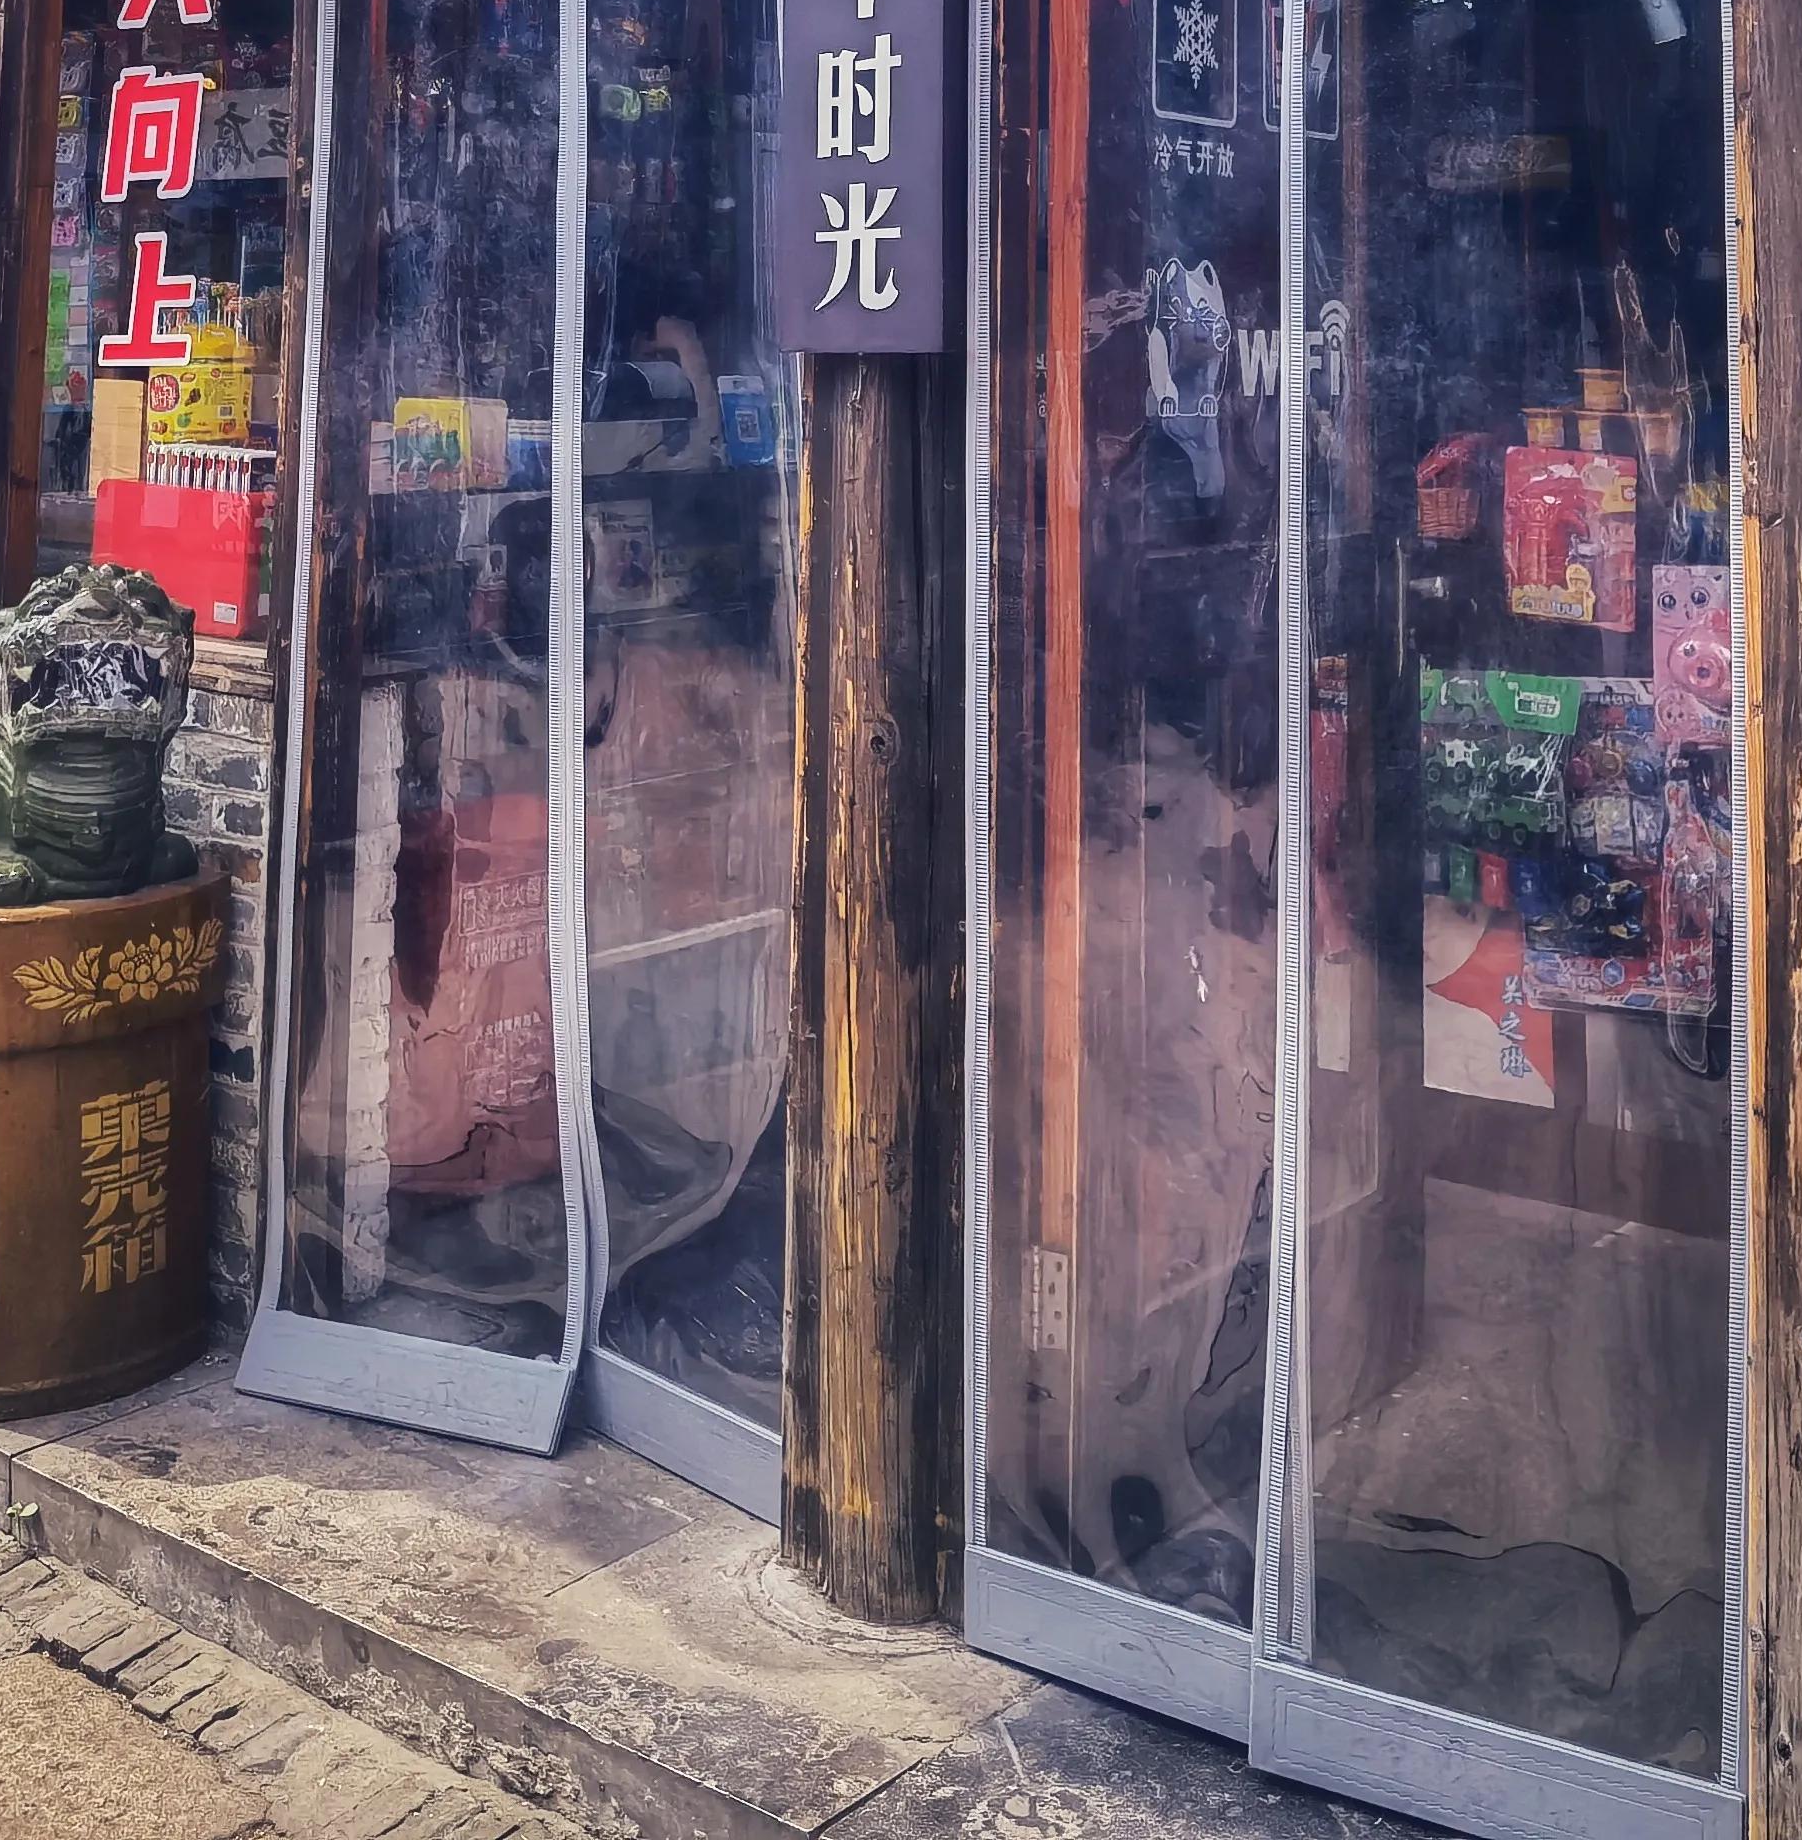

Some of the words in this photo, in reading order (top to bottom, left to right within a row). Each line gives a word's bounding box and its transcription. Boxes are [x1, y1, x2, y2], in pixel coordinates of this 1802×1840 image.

[1153, 133, 1235, 179] 冷气开放
[1236, 327, 1342, 397] WFi
